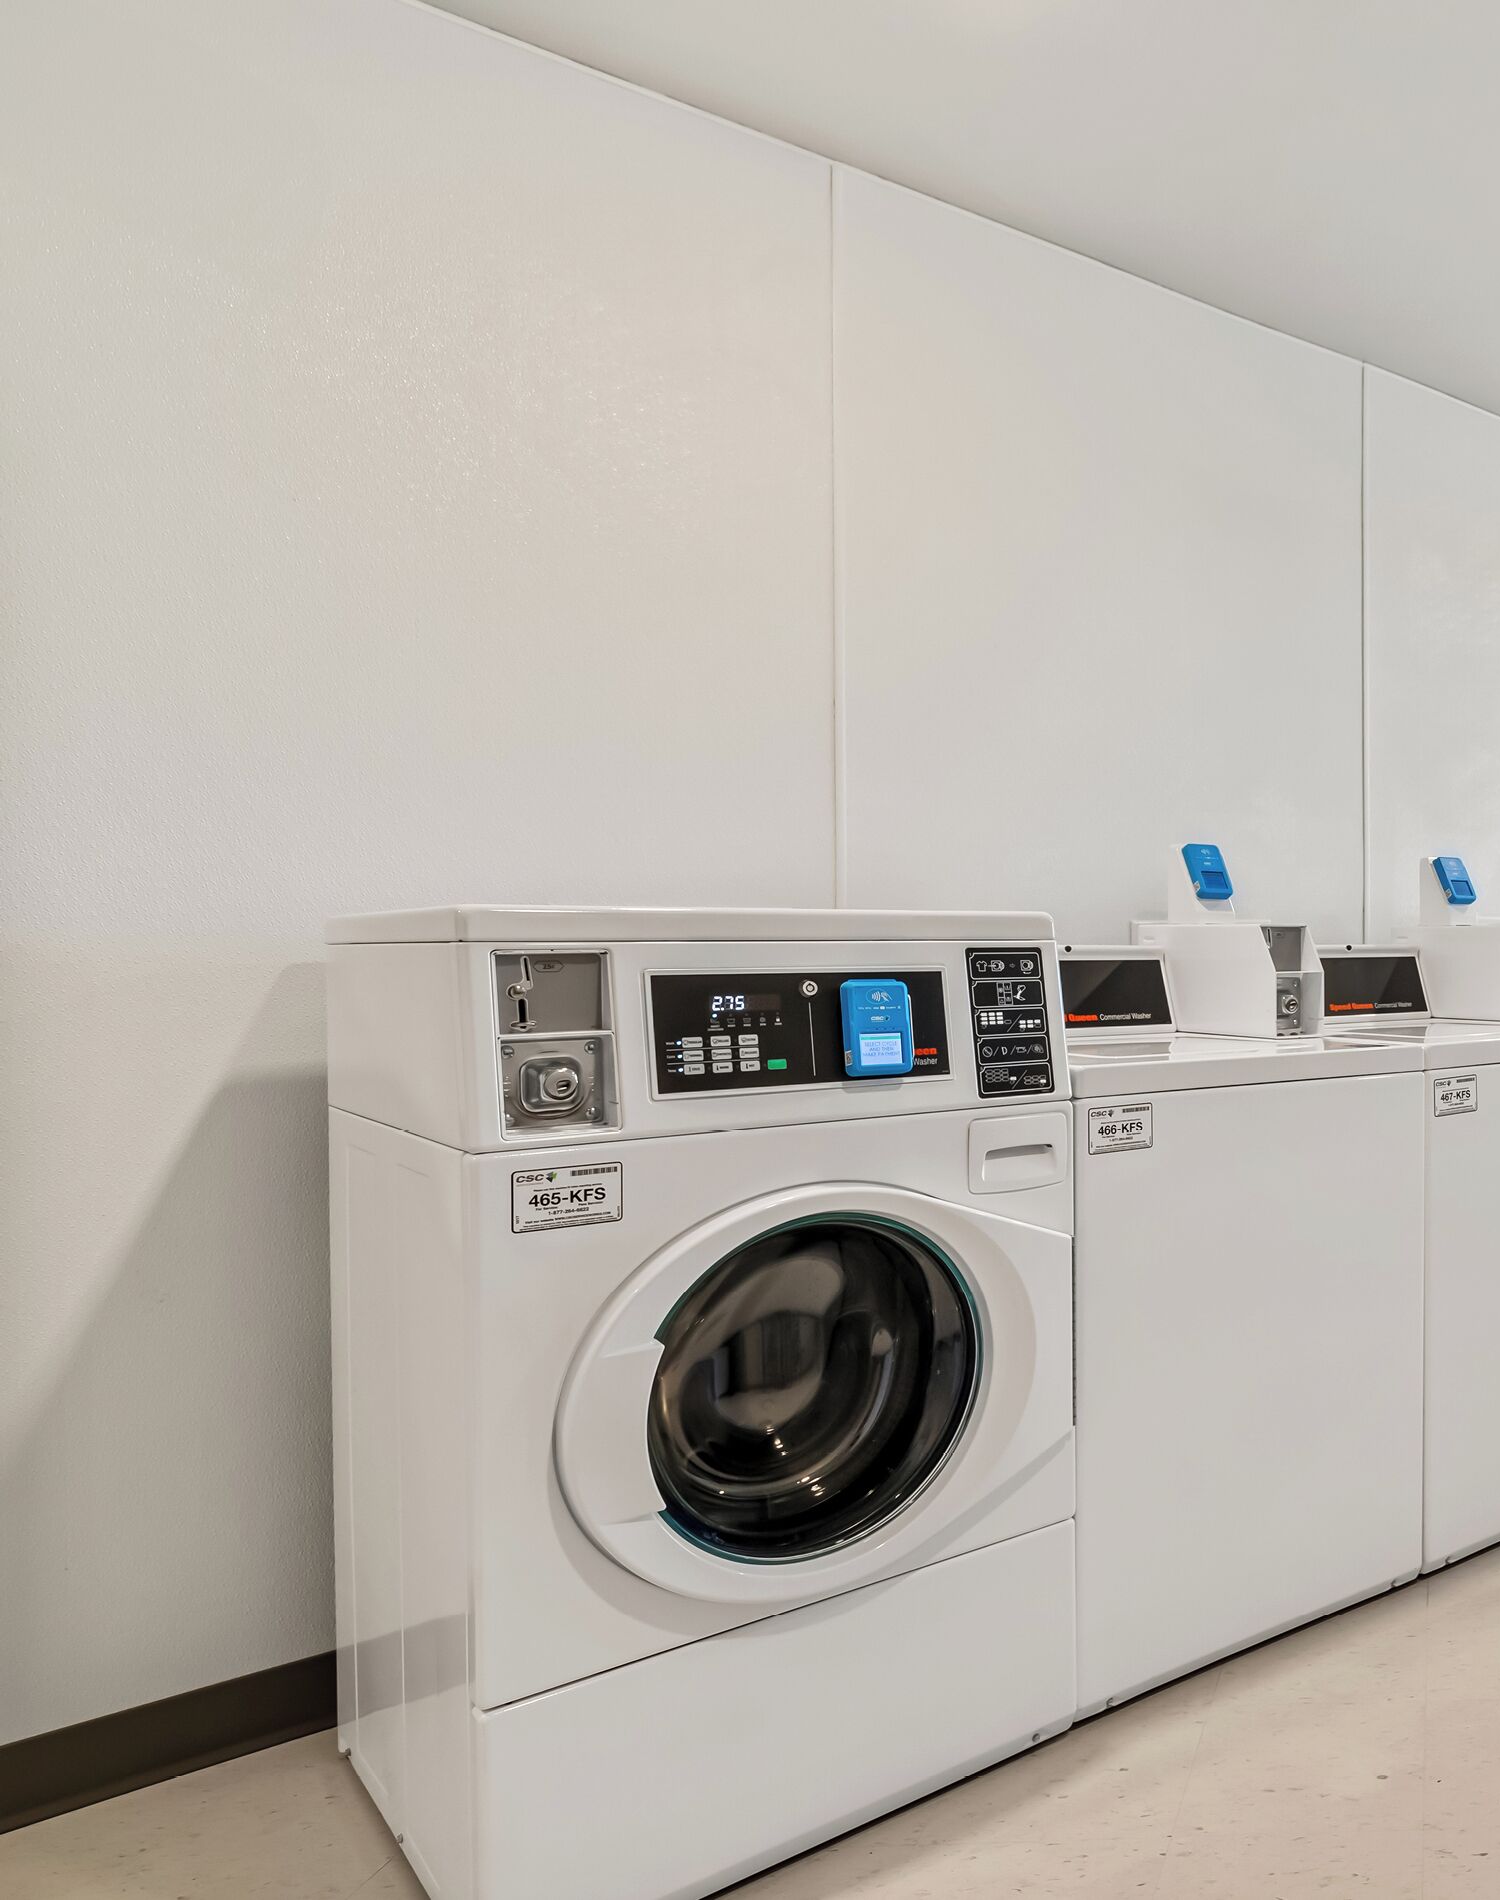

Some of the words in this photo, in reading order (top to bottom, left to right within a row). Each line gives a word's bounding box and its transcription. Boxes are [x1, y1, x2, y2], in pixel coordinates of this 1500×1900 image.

[712, 995, 745, 1011] 2.75
[1068, 1013, 1099, 1022] Queen
[1099, 1013, 1131, 1021] Commercial
[1131, 1012, 1152, 1020] Washer
[1440, 1090, 1471, 1102] 467-KFS
[1090, 1110, 1107, 1118] CSC
[1097, 1121, 1143, 1136] 466-KFS
[516, 1174, 544, 1183] CSC
[529, 1187, 606, 1207] 465-KFS
